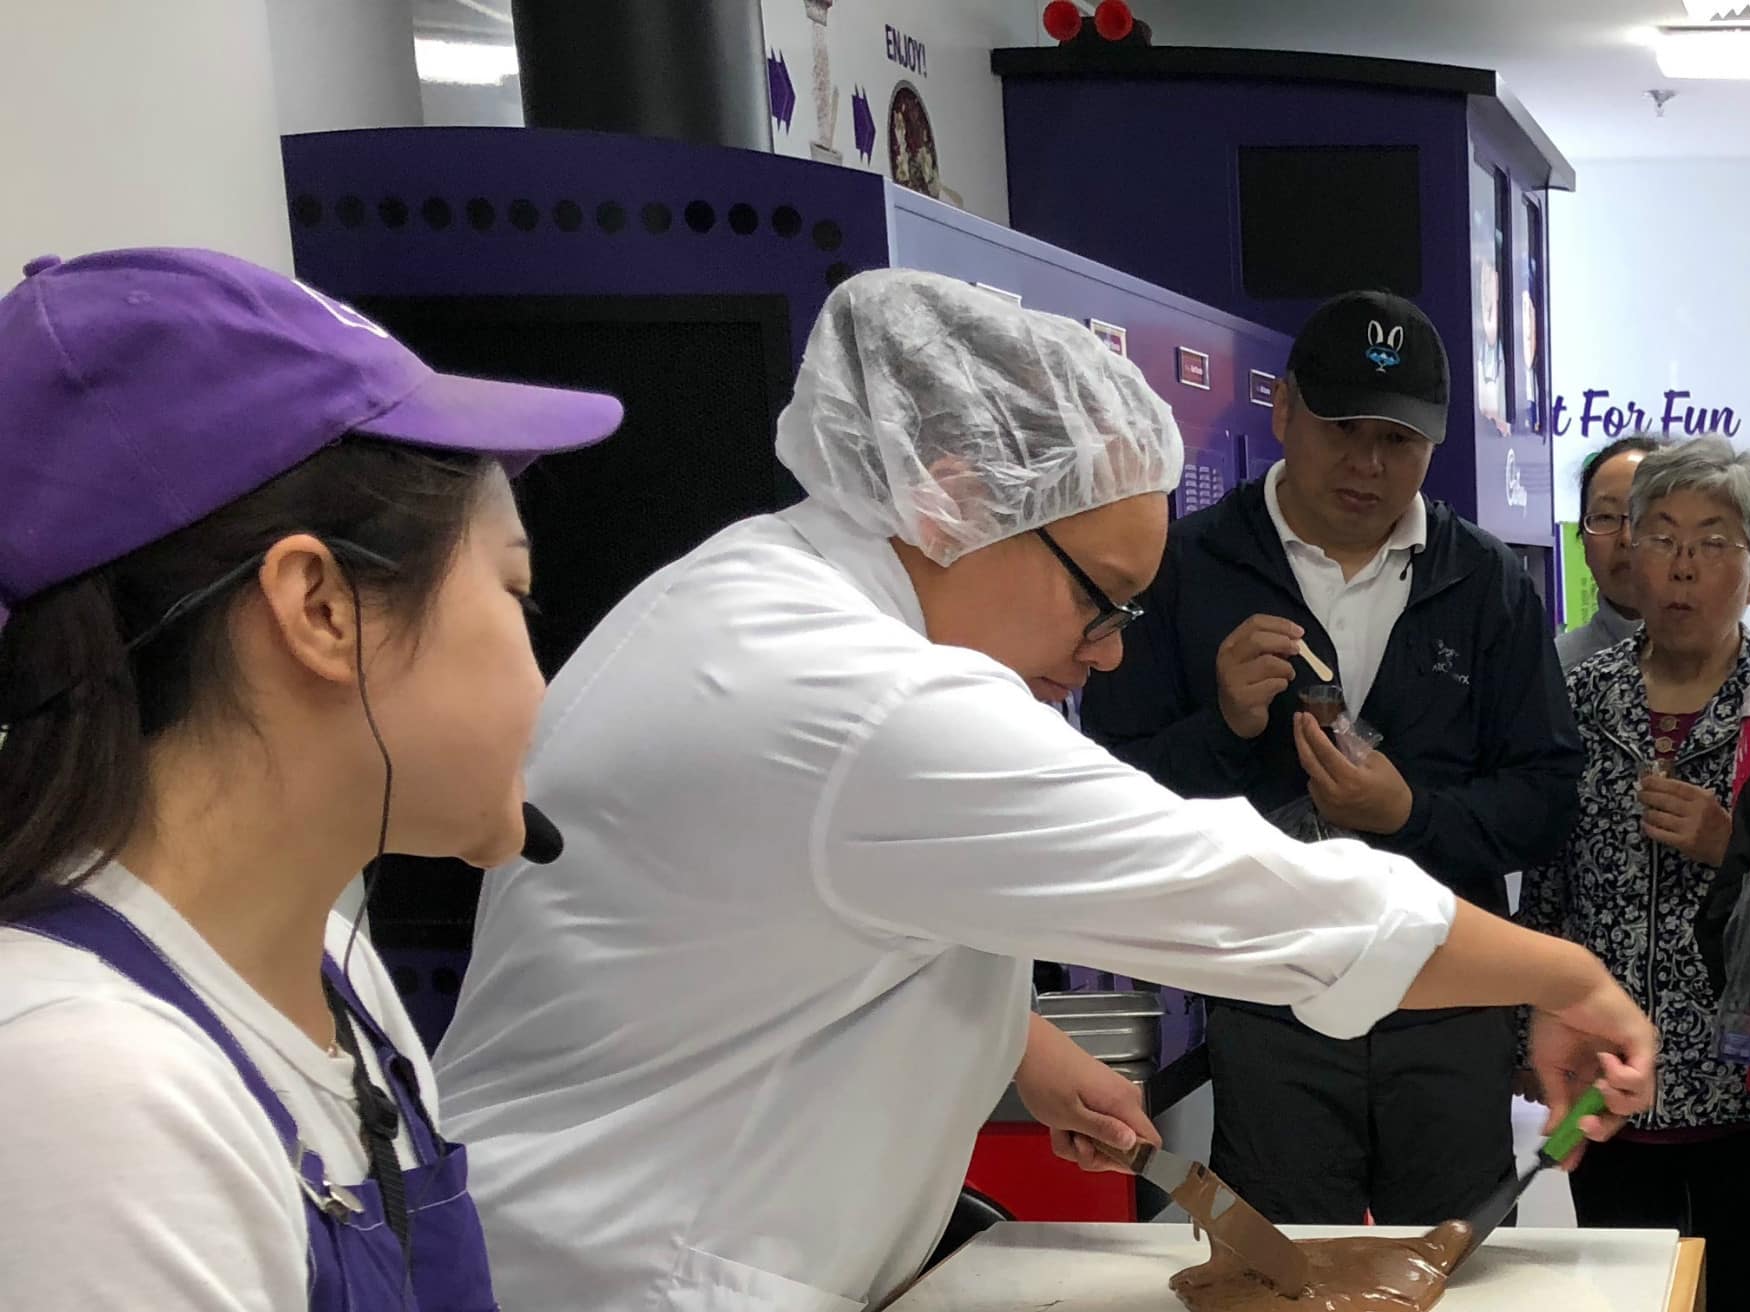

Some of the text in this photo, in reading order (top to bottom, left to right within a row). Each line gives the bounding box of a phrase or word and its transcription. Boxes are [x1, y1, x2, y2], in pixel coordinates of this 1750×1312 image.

[885, 23, 928, 79] ENJOY!
[1580, 389, 1652, 438] For
[1661, 389, 1741, 438] Fun
